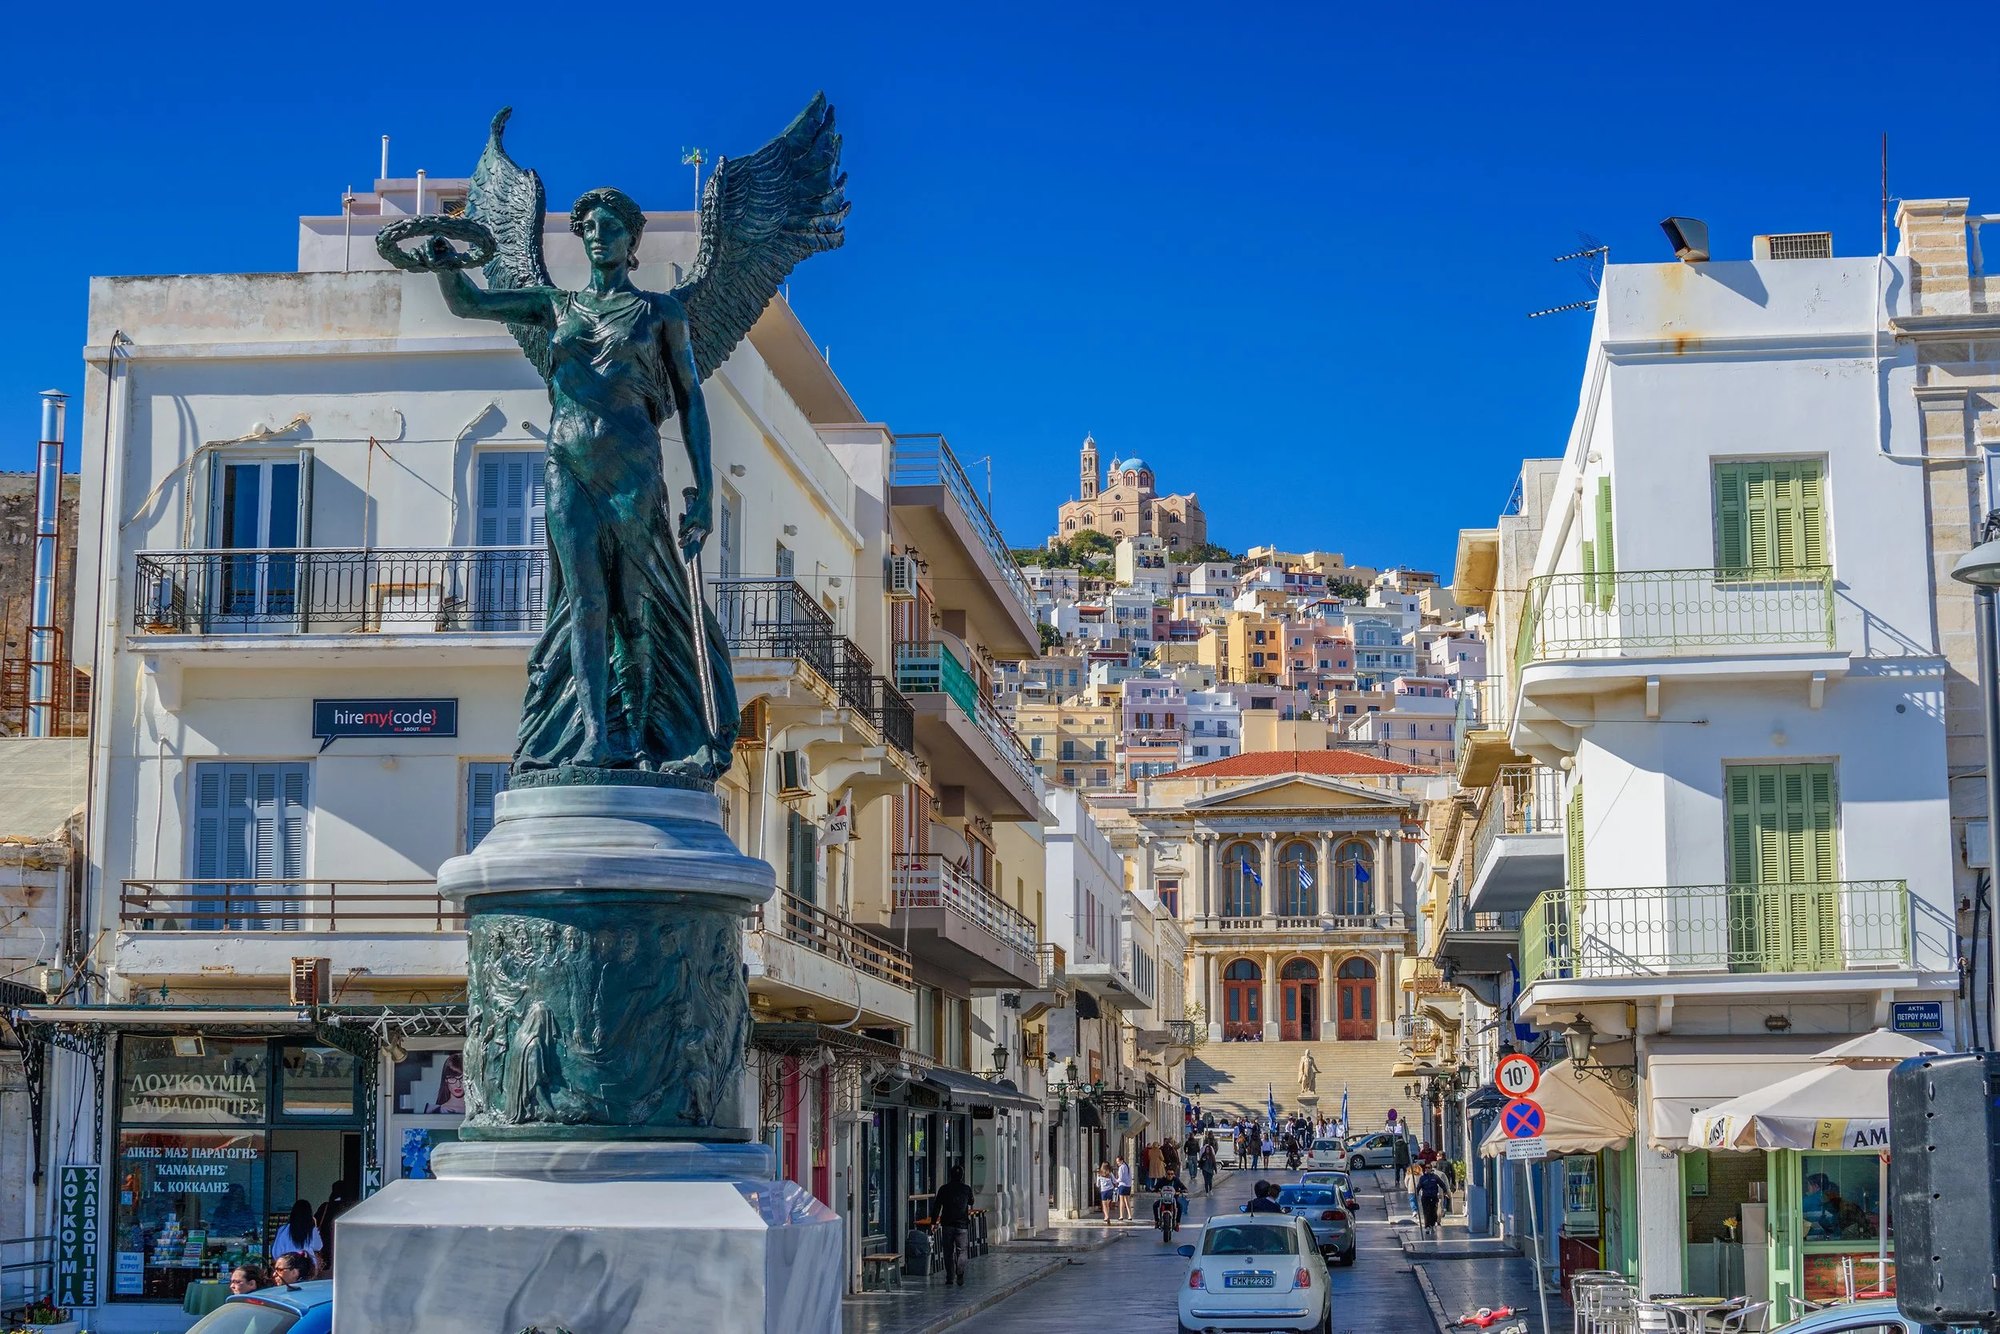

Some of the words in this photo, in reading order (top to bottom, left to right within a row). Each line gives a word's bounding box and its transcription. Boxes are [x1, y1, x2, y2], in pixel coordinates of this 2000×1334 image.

[335, 709, 437, 727] hiremy{code}
[1920, 1012, 1938, 1020] ΡΑΛΛΗ
[131, 1074, 256, 1093] ΛΟΥΚΟΥΜΙΑ
[127, 1147, 162, 1158] ΔΙΚΗΣ
[165, 1147, 189, 1158] ΜΑΣ
[191, 1147, 258, 1159] ΠΑΡΑΓΩΓΗΣ
[153, 1181, 165, 1193] Κ.
[167, 1181, 230, 1193] ΚΟΚΚΑΛΗΣ
[62, 1168, 78, 1305] ΛΟΥΚΟΥΜΙΑ
